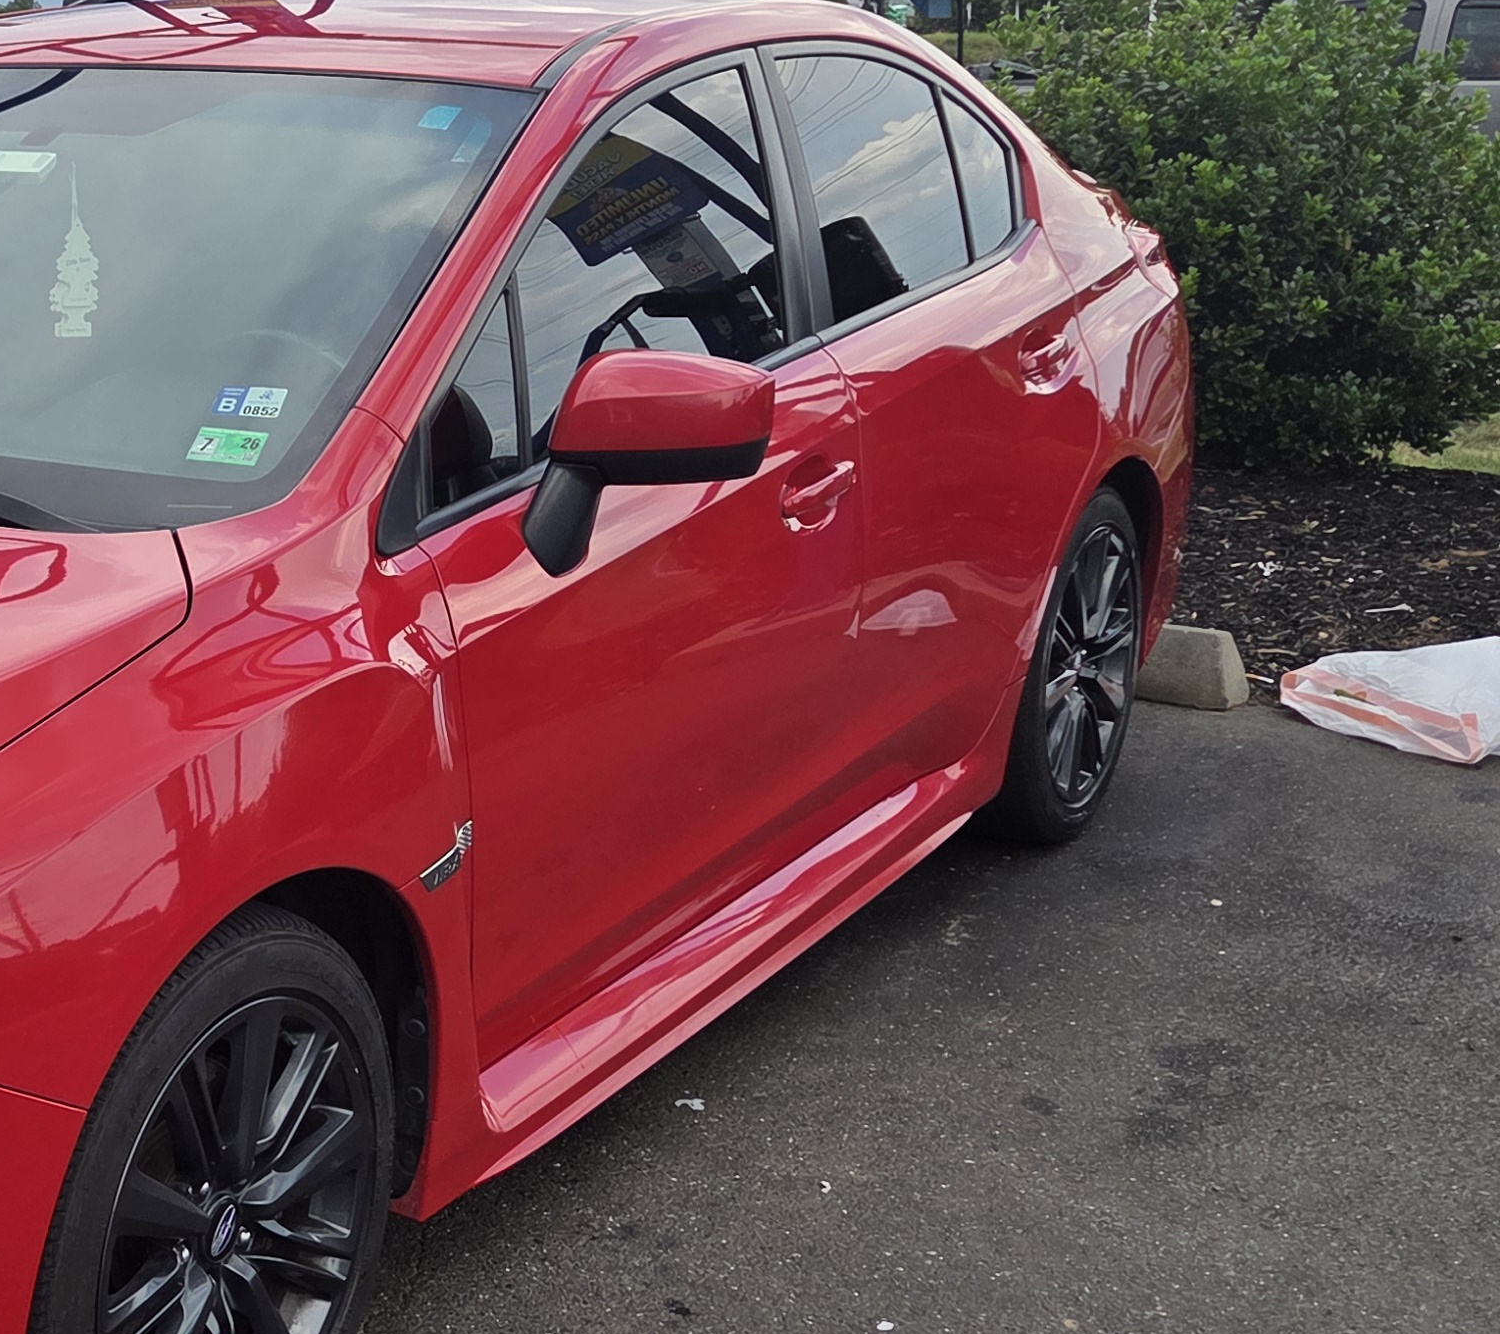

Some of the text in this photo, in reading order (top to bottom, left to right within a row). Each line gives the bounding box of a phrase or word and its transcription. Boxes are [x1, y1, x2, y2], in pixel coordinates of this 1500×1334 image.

[217, 397, 237, 412] B
[243, 405, 278, 416] 0852
[200, 437, 261, 451] 7 26
